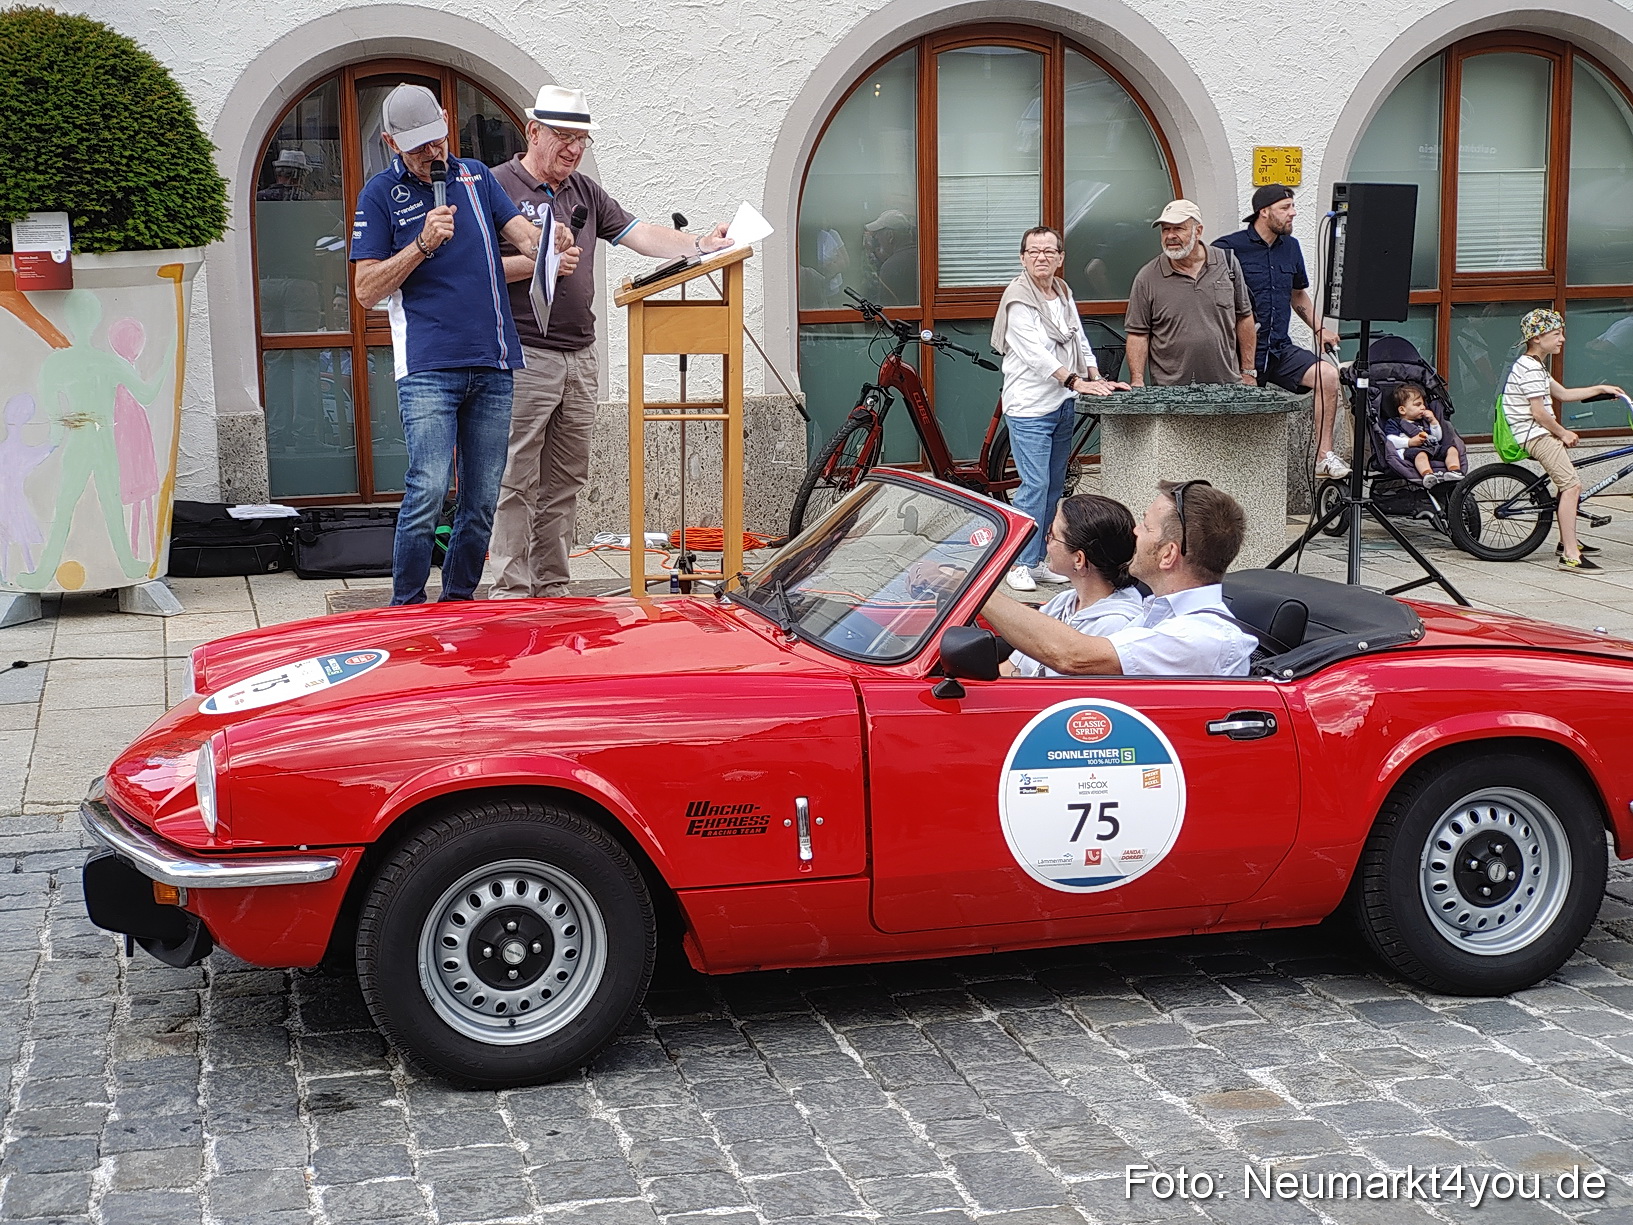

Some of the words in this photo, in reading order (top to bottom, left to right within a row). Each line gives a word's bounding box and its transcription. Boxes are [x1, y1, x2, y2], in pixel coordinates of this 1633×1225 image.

[1261, 155, 1267, 163] S
[1285, 155, 1291, 163] S
[913, 392, 930, 425] CUBE
[1580, 473, 1618, 501] Sunday
[1073, 720, 1106, 728] CLASSIC
[1047, 749, 1119, 760] SONNLEITNER
[1078, 781, 1108, 789] HISCOX
[686, 815, 771, 835] EXPRESS
[1067, 801, 1120, 842] 75
